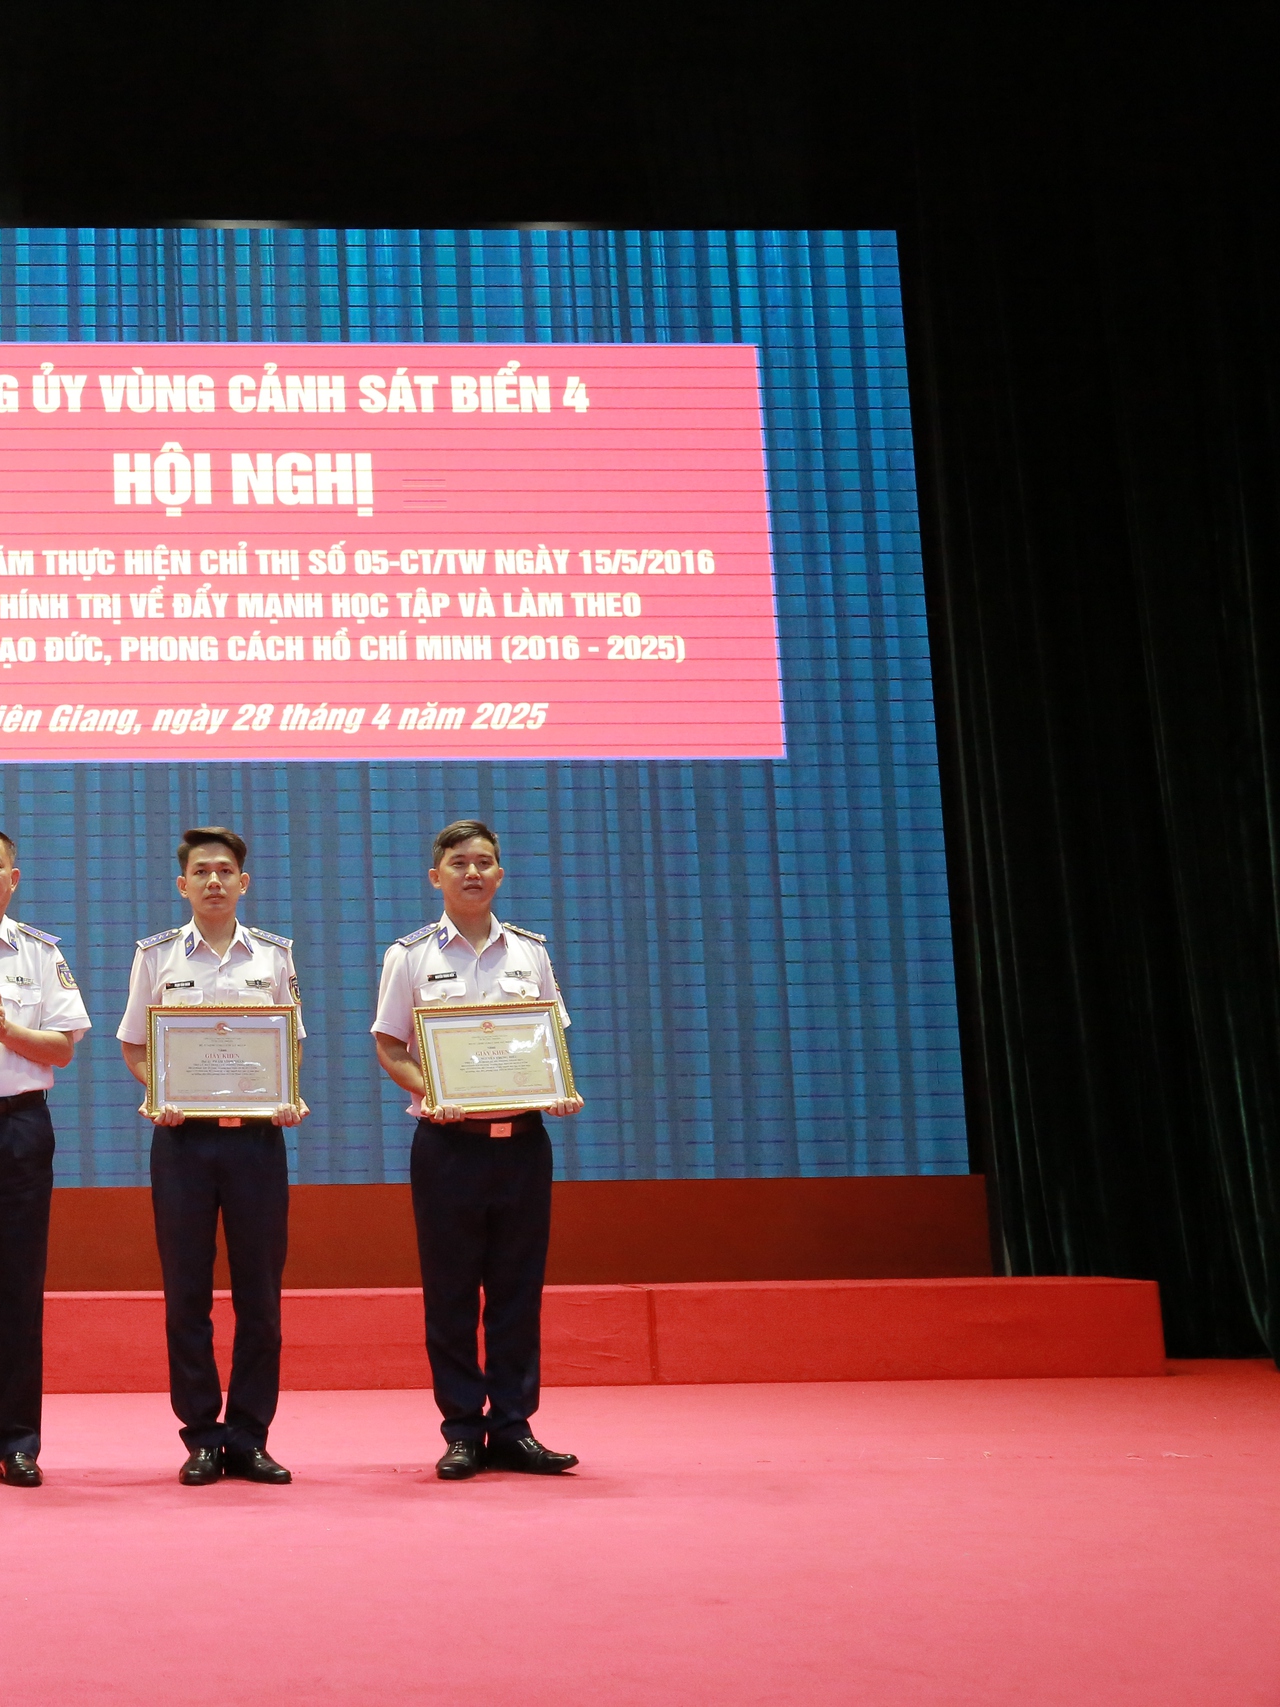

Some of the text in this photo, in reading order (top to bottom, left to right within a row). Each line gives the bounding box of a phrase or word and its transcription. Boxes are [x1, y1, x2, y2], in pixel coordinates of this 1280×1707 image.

[32, 362, 87, 413] ỦY
[99, 367, 215, 413] VÙNG
[228, 363, 345, 413] CẢNH
[358, 368, 438, 413] SÁT
[451, 360, 551, 413] BIỂN
[563, 376, 589, 413] 4
[113, 442, 373, 517] HỘI NGHỊ
[42, 548, 116, 581] THỰC
[124, 545, 191, 581] HIỆN
[199, 541, 248, 576] CHỈ
[255, 549, 300, 581] THỊ
[308, 541, 347, 575] SỐ
[354, 549, 486, 575] 05-CT/TW
[495, 544, 570, 575] NGÀY
[579, 549, 715, 575] 15/5/2016
[76, 593, 121, 625] TRỊ
[129, 585, 164, 619] VỀ
[172, 583, 229, 619] ĐẨY
[238, 593, 323, 624] MẠNH
[331, 593, 388, 624] HỌC
[396, 588, 450, 624] TẬP
[458, 587, 495, 618] VÀ
[503, 587, 563, 618] LÀM
[571, 592, 642, 618] THEO
[44, 631, 112, 666] ĐỨC,
[120, 636, 218, 662] PHONG
[227, 631, 304, 662] CÁCH
[312, 627, 350, 661] HỒ
[359, 630, 407, 661] CHÍ
[416, 635, 492, 661] MINH
[501, 635, 580, 664] (2016
[607, 635, 686, 664] 2025)
[49, 704, 142, 735] Giang,
[151, 704, 228, 735] ngày
[231, 704, 274, 731] 28
[279, 703, 366, 735] tháng
[371, 704, 392, 731] 4
[398, 702, 465, 731] năm
[471, 702, 549, 730] 2025
